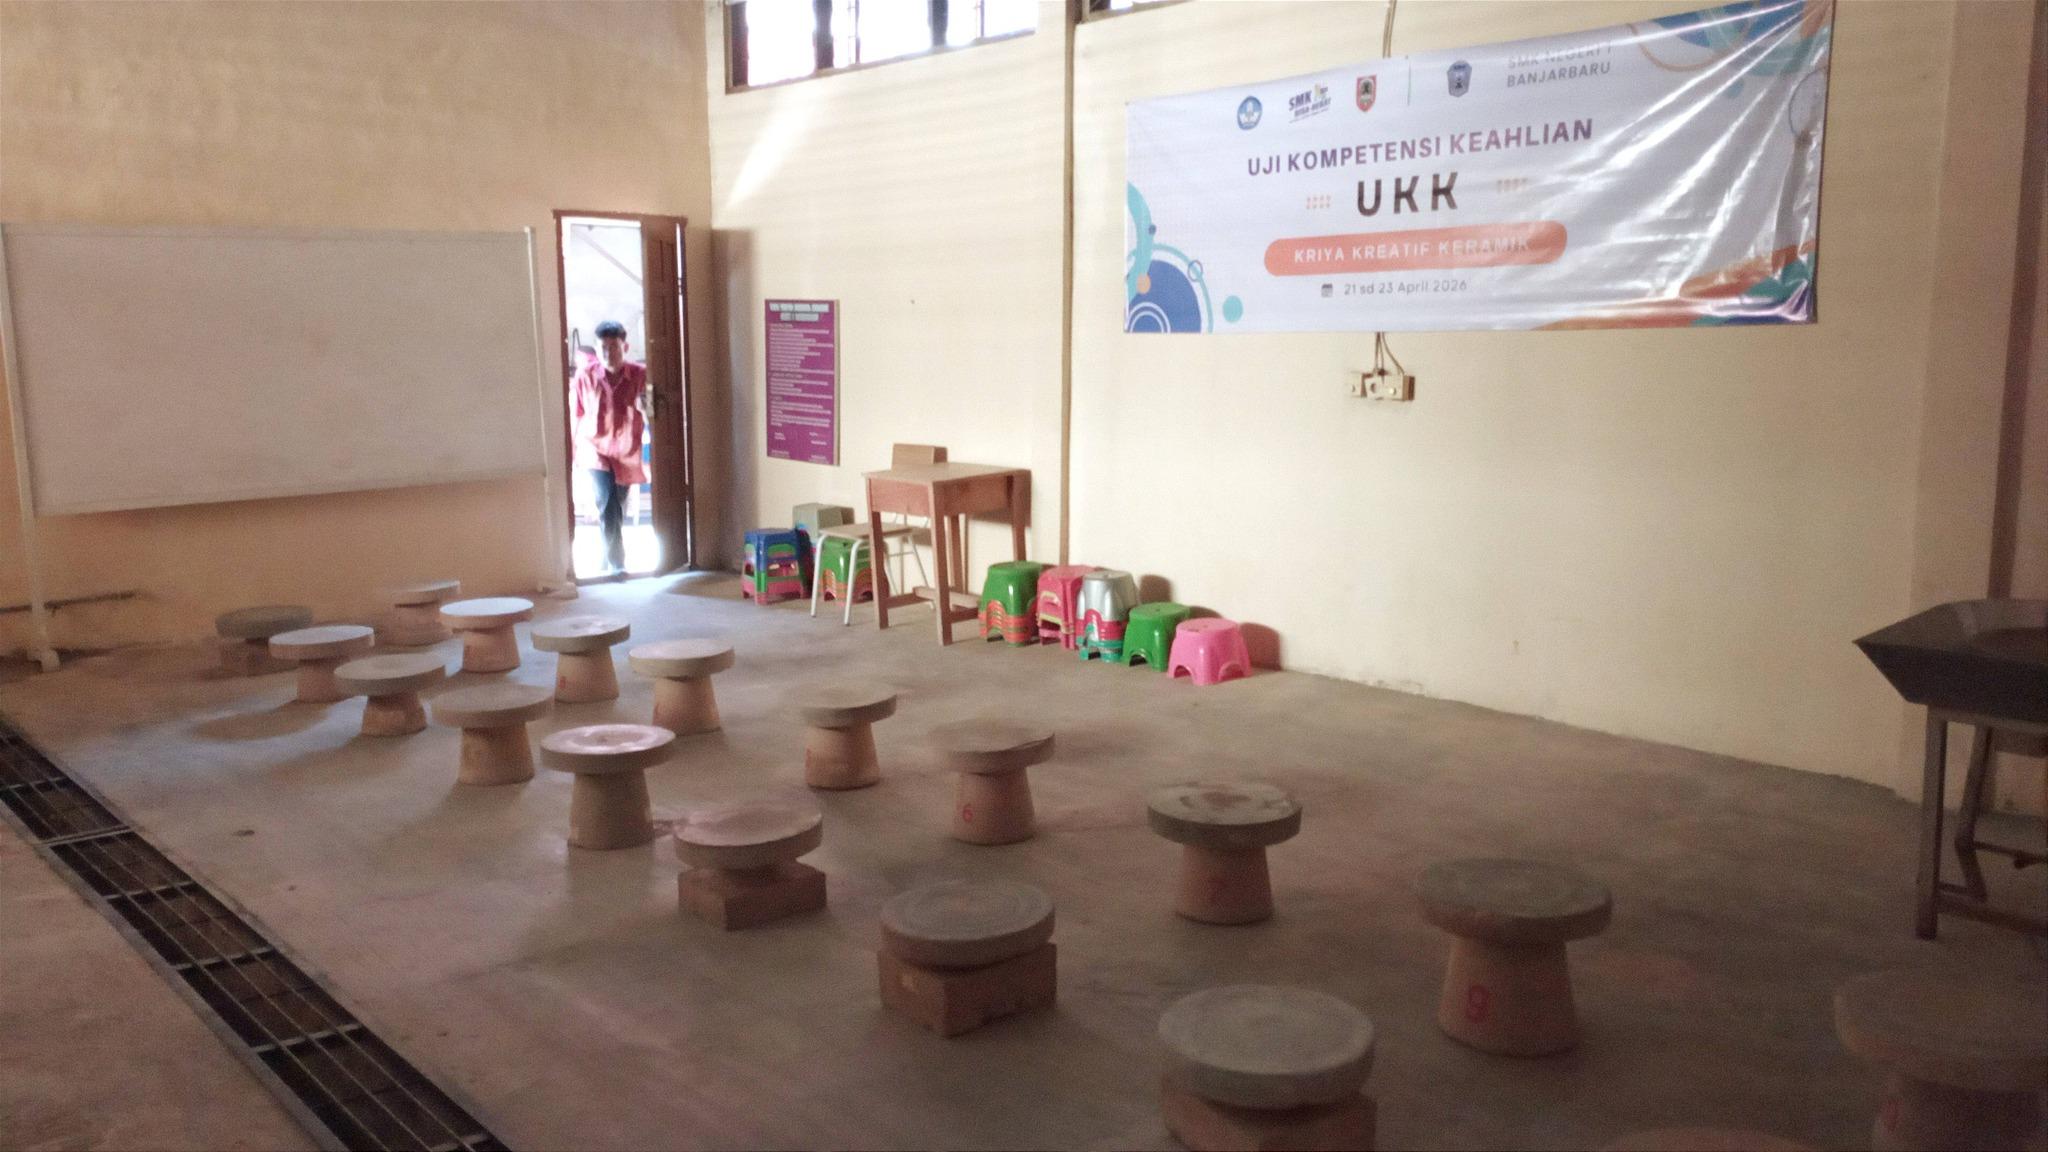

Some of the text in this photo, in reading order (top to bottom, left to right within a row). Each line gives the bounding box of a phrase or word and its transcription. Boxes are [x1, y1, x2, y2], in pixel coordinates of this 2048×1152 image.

[1506, 62, 1611, 88] BANJARBARU
[1289, 91, 1312, 112] SMK
[1248, 118, 1593, 176] UJI KOMPETENSI KEAHLIAN
[1357, 172, 1459, 217] UKK
[1295, 247, 1345, 263] KRIYA
[1352, 241, 1431, 260] KREATIF
[1344, 279, 1468, 295] 21 sd 23 April 2026
[962, 803, 974, 824] 6
[1467, 984, 1489, 1021] 9
